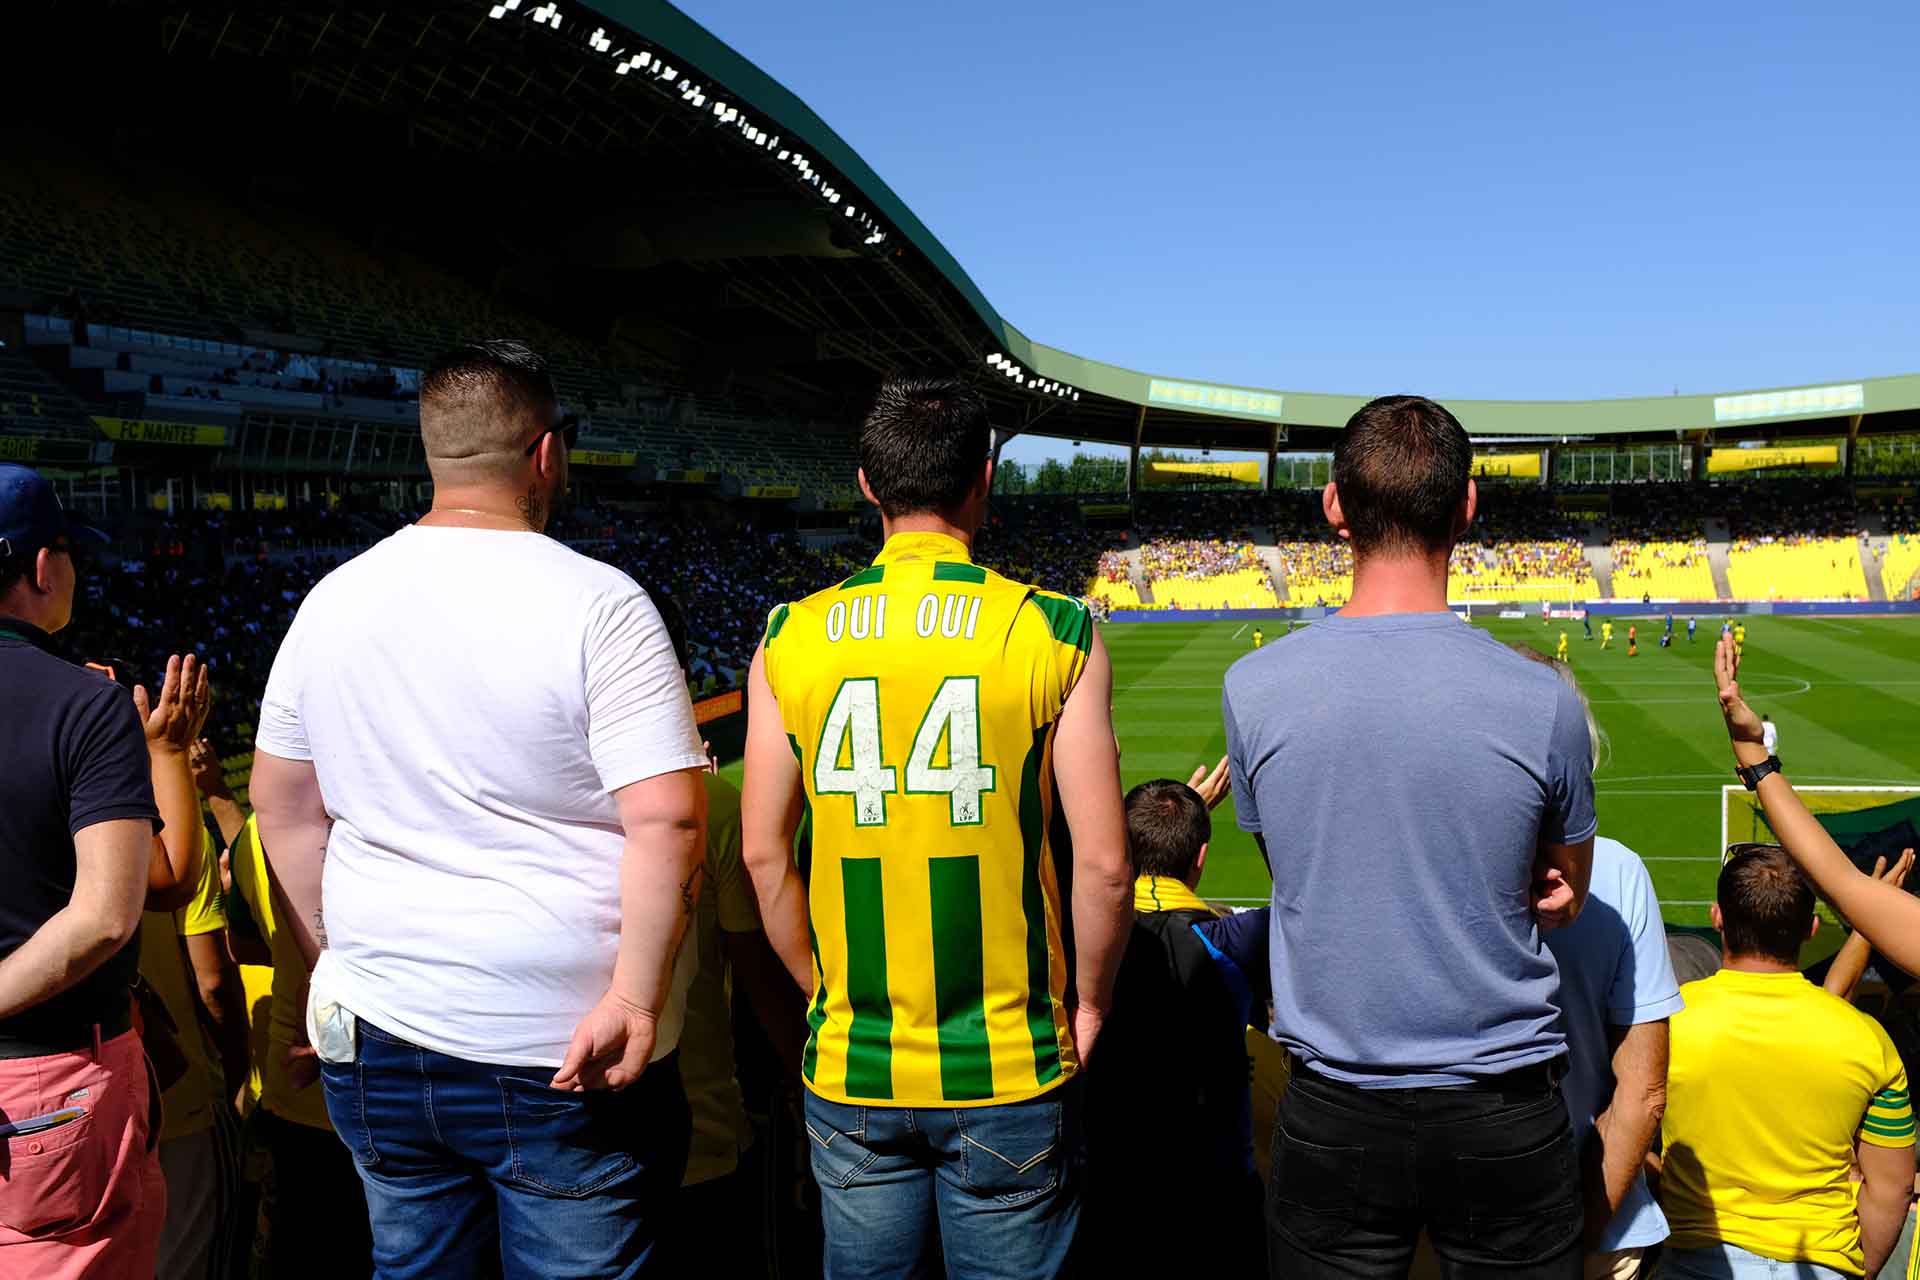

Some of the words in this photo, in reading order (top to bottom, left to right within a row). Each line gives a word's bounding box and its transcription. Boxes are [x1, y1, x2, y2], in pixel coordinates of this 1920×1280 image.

[120, 421, 139, 440] FC
[144, 423, 196, 444] NANTES
[826, 595, 887, 642] OUI
[916, 594, 982, 640] OUI
[813, 676, 996, 827] 44
